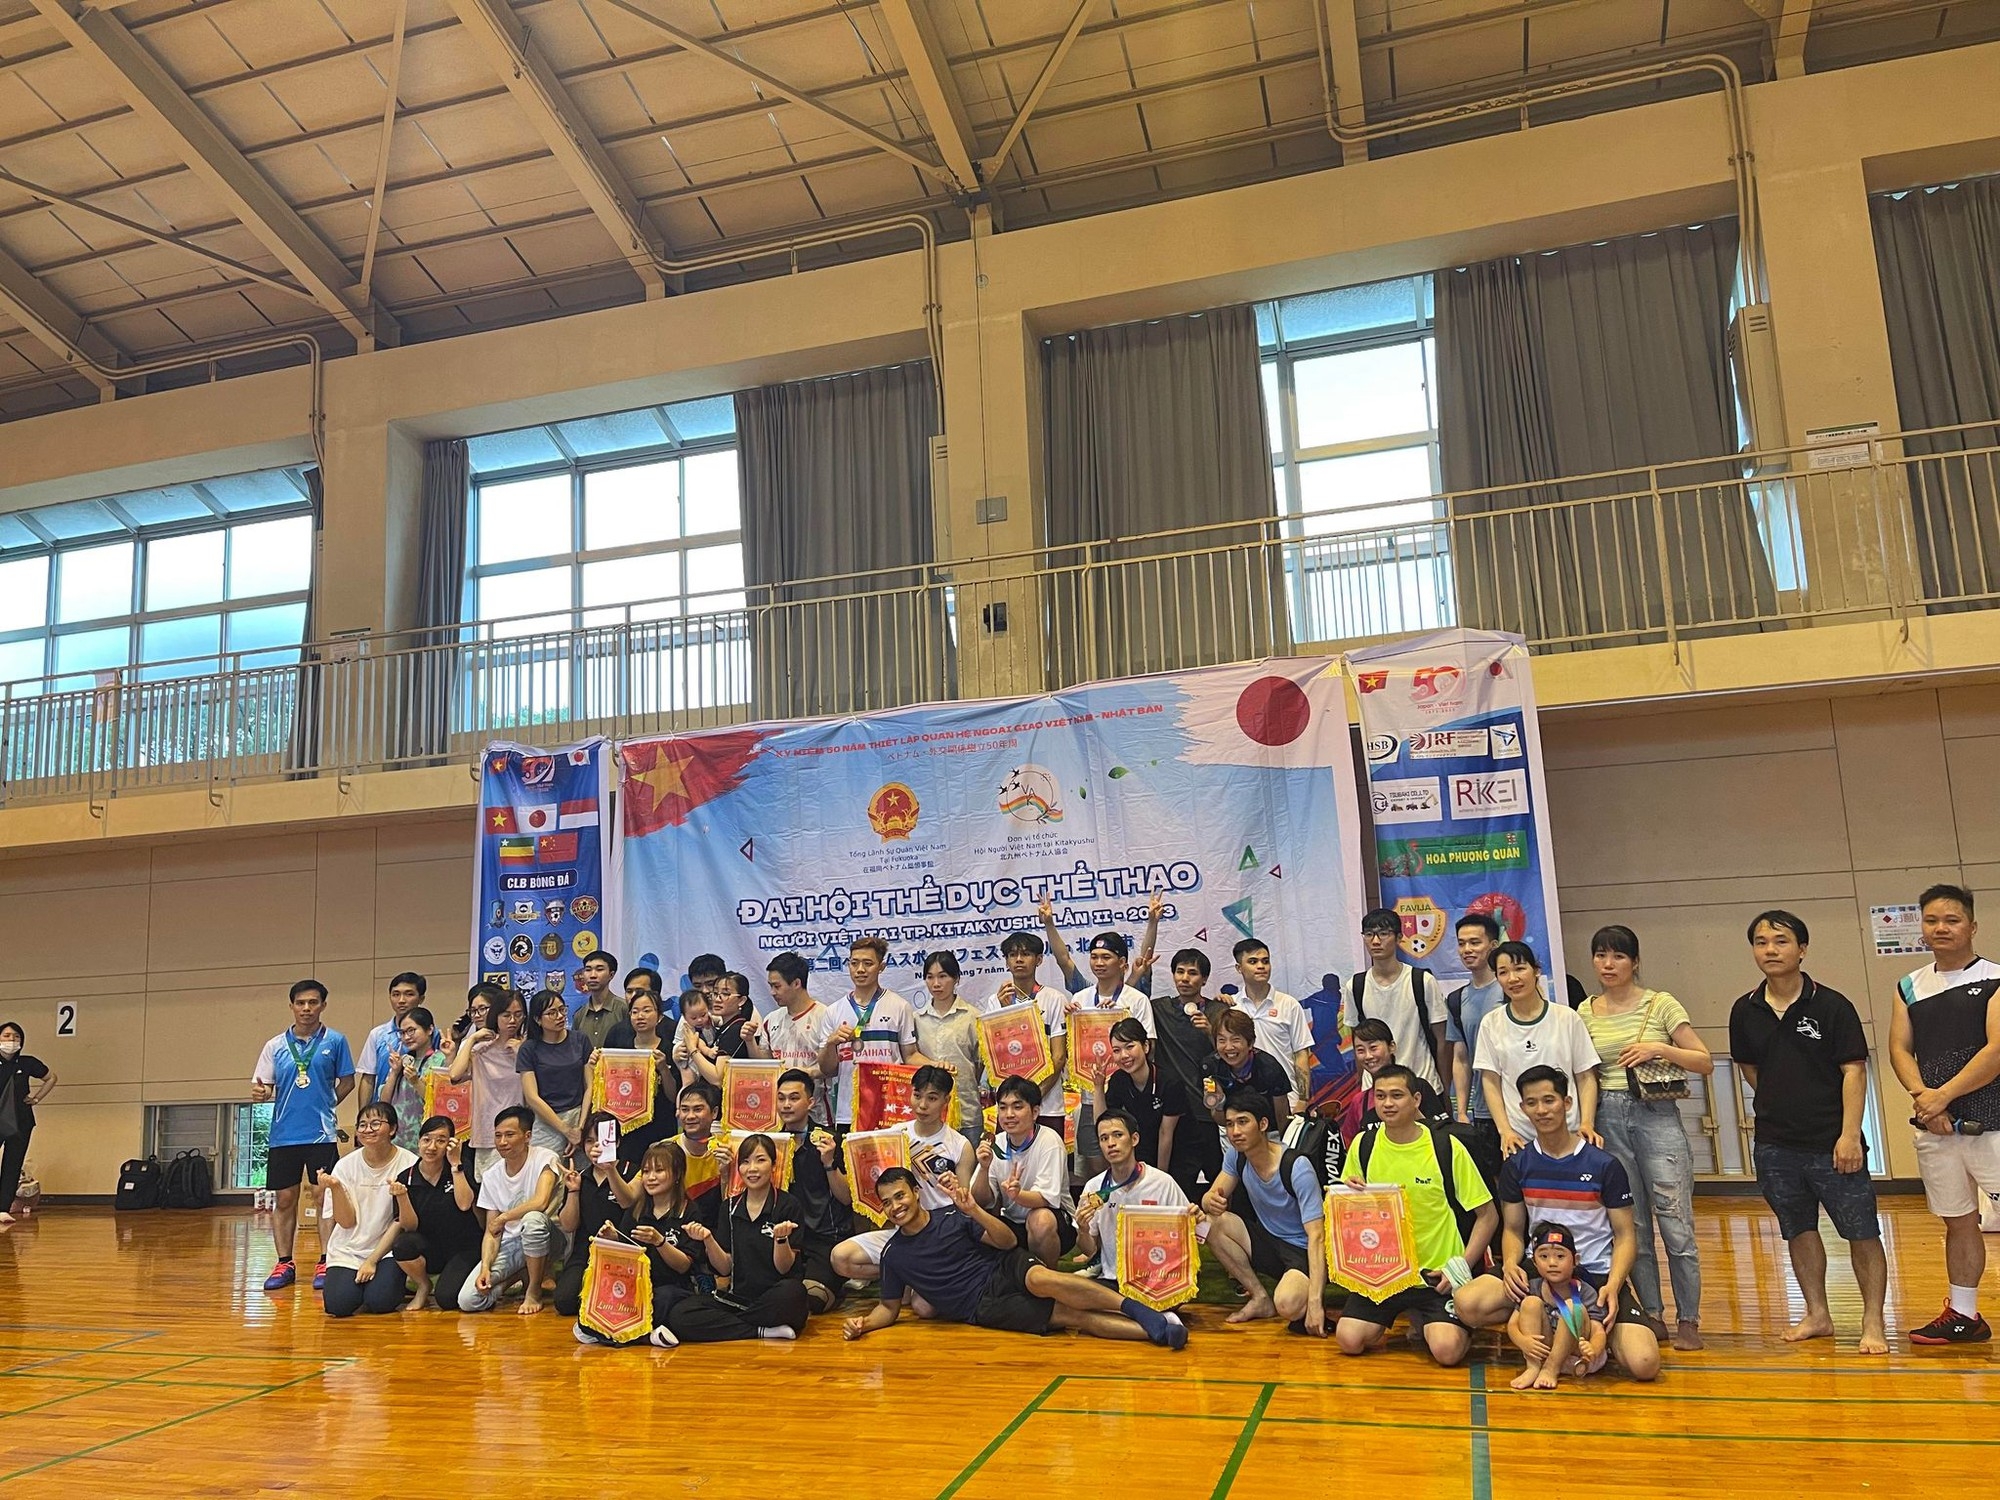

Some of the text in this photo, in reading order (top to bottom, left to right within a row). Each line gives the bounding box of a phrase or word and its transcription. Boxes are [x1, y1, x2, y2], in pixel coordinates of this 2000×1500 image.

[921, 731, 954, 742] QUAN
[1014, 721, 1043, 732] GIAO
[1427, 731, 1456, 749] JRF
[930, 843, 947, 851] Nam
[1025, 841, 1043, 849] Nam
[1055, 837, 1095, 847] Kitakyushu
[891, 854, 919, 862] Fukuoka
[1425, 853, 1447, 864] HOA
[507, 871, 570, 889] CLB BÓNG ĐÁ
[738, 860, 1200, 928] ĐẠI HỘI THỂ DỤC THỂ THAO
[1400, 903, 1432, 913] FAVIJA
[759, 930, 816, 949] NGƯỜI
[819, 928, 862, 947] VIỆT
[1092, 908, 1113, 925] II
[1126, 903, 1177, 921] 203
[976, 967, 984, 975] 7
[58, 1005, 74, 1035] 2
[1325, 1130, 1340, 1184] YONEX
